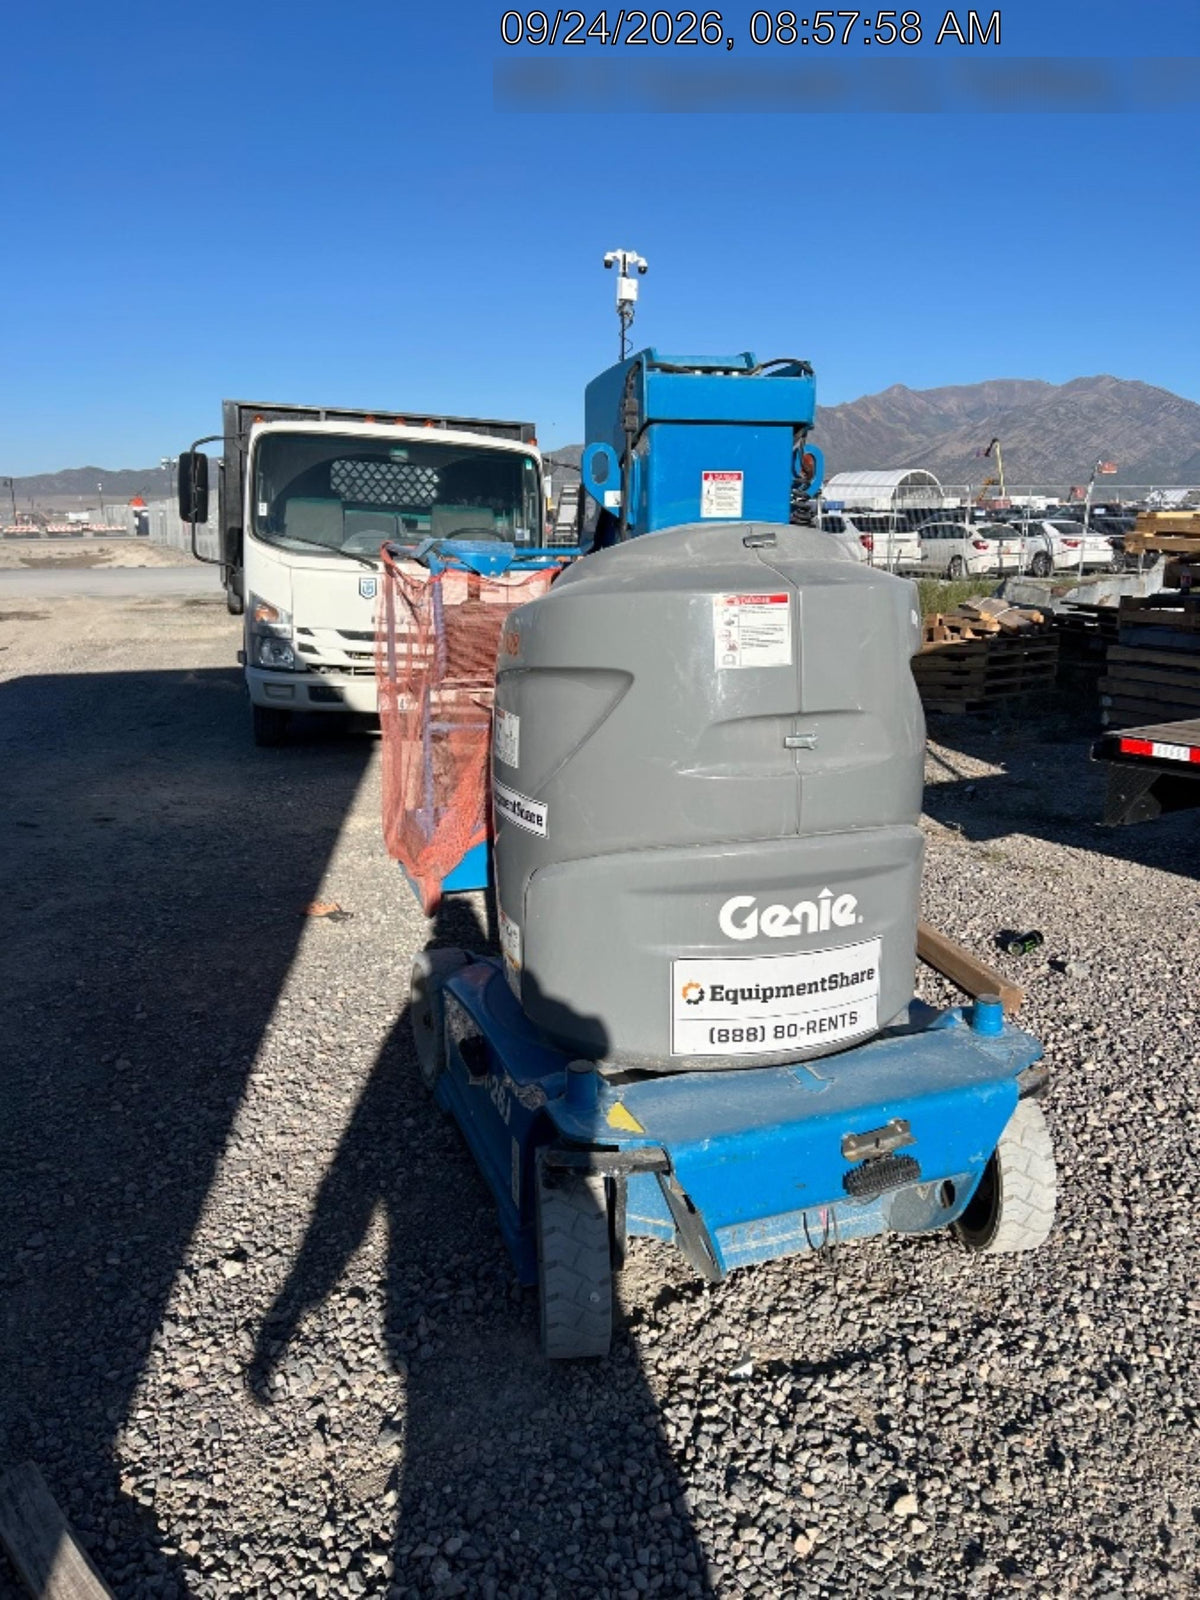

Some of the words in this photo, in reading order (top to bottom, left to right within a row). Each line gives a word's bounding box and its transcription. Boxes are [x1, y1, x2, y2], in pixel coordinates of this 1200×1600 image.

[709, 967, 875, 1005] EquipmentShare
[709, 1025, 766, 1044] (888)
[773, 1011, 860, 1040] 80-RENTS
